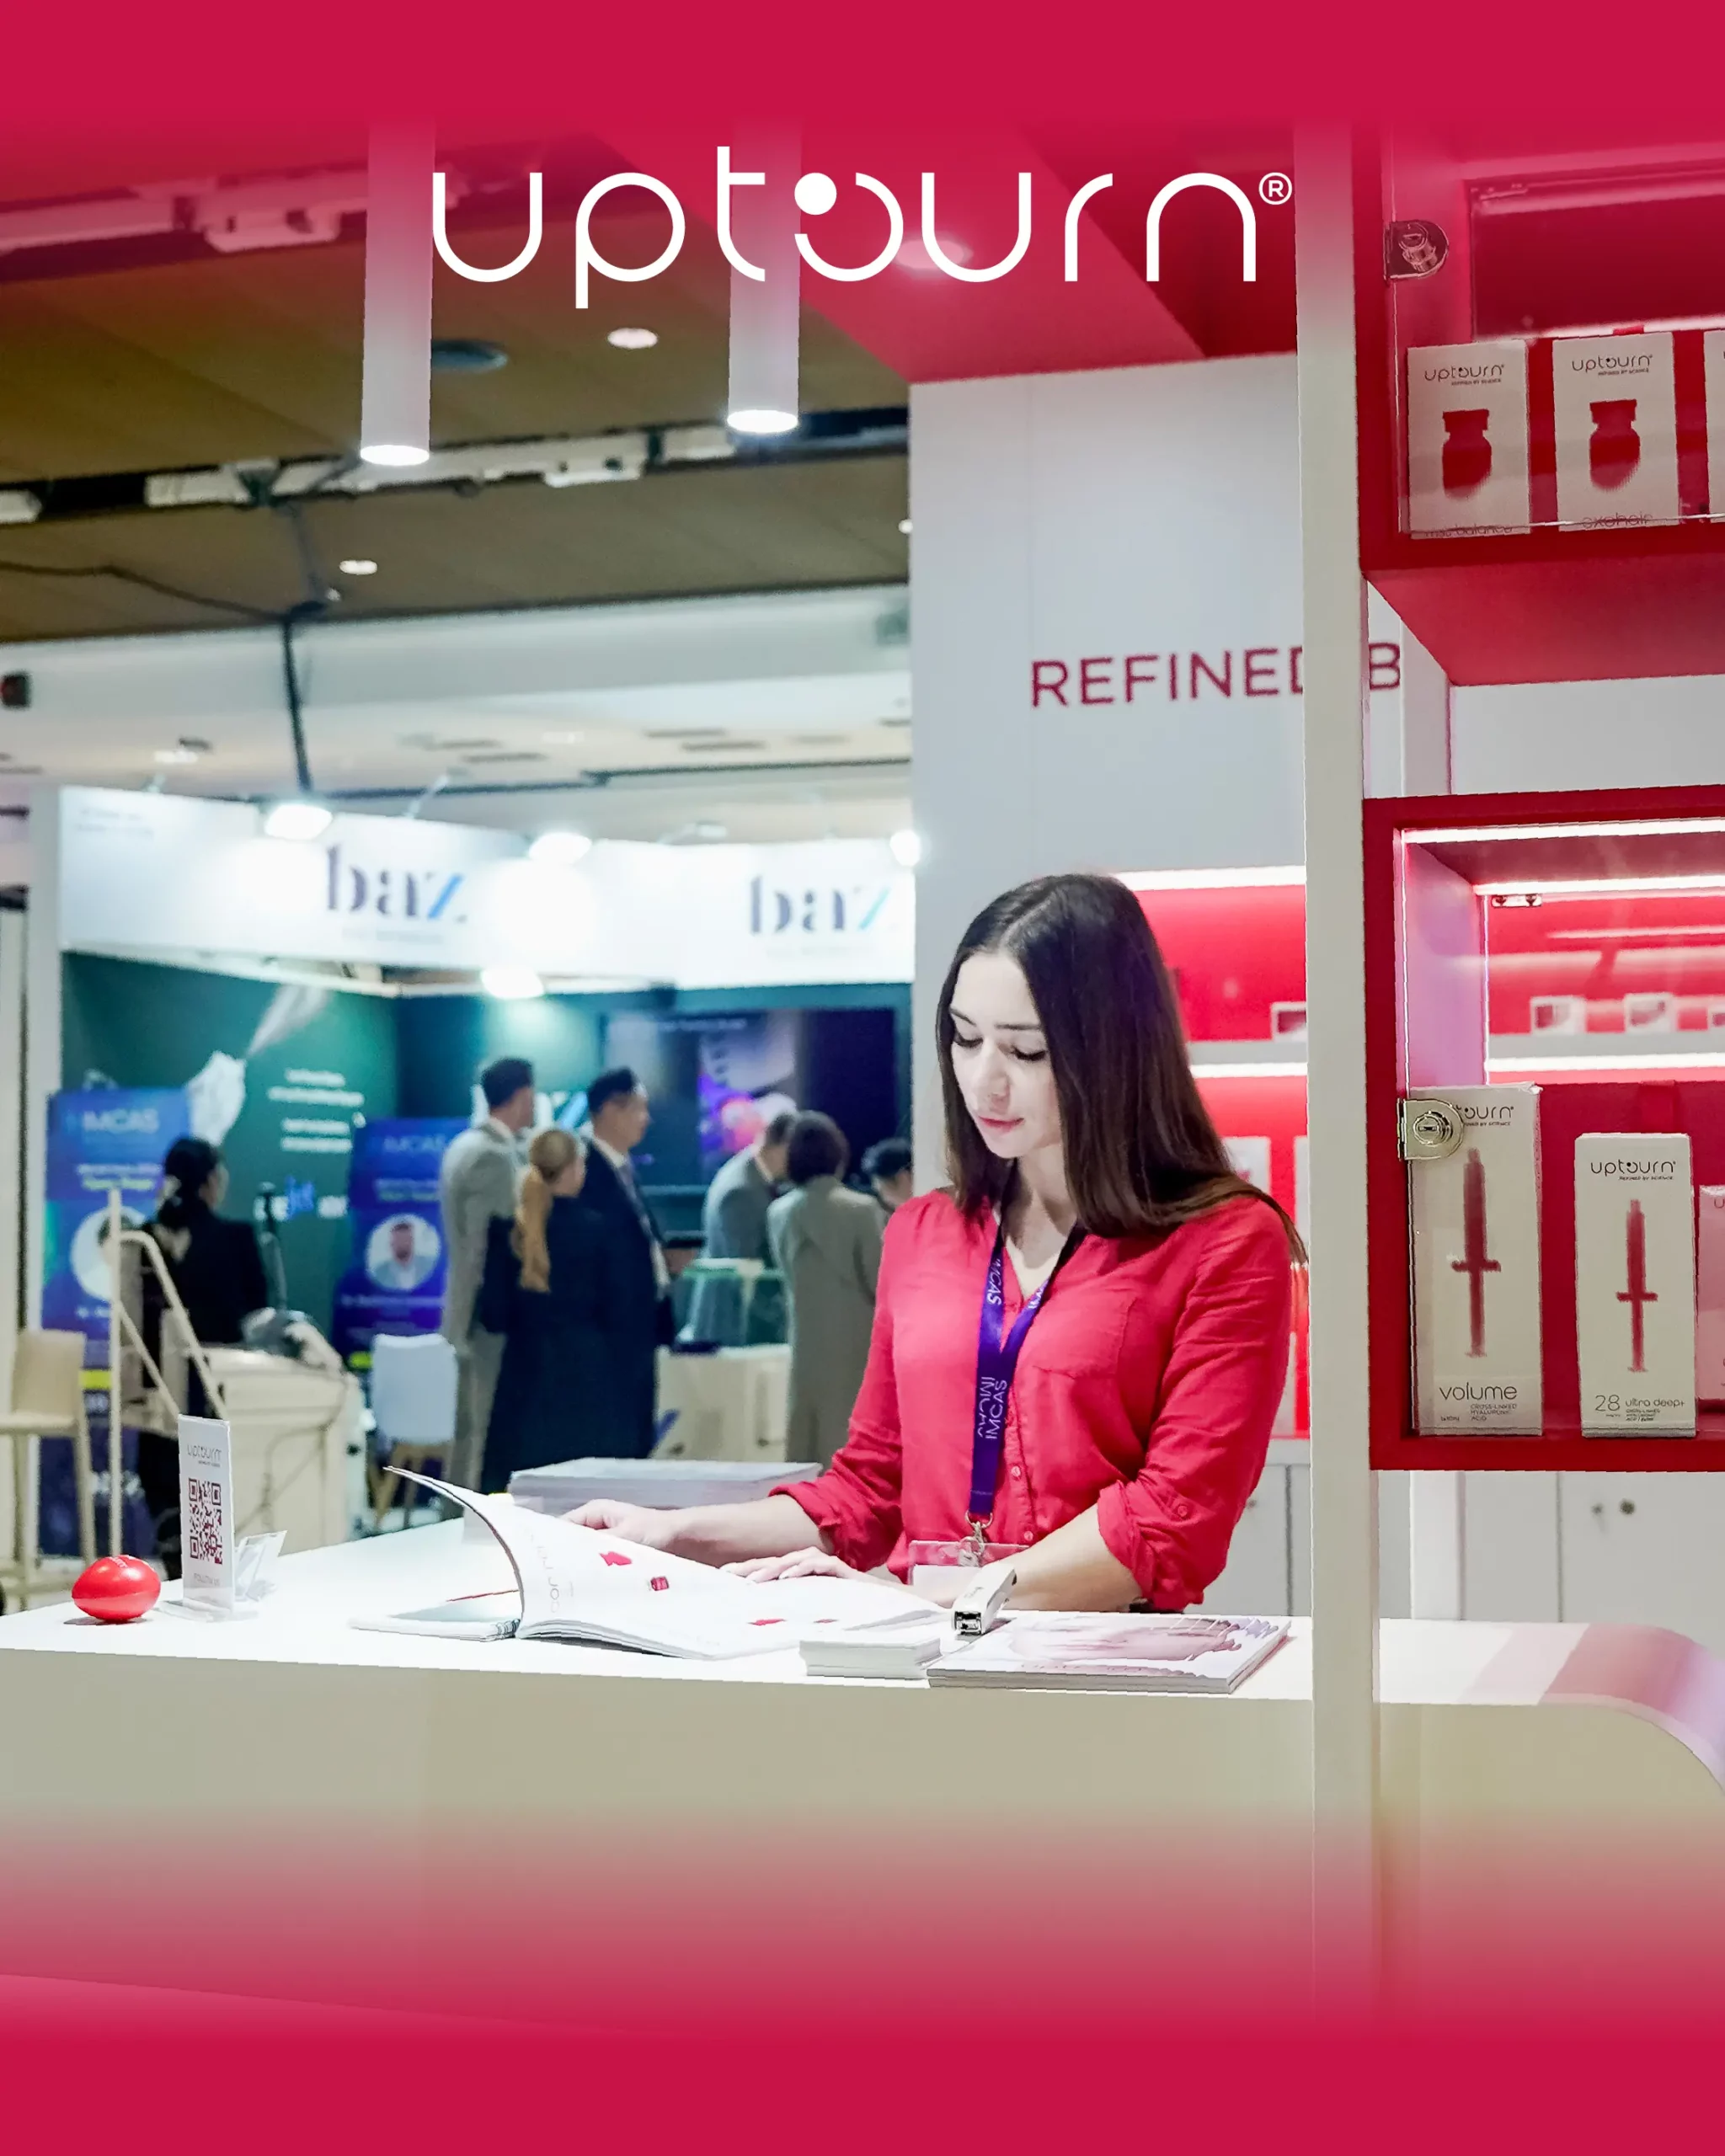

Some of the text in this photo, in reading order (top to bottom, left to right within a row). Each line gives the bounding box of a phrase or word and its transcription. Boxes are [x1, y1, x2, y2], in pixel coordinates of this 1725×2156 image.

[1030, 645, 1303, 708] REFINE
[985, 1380, 1007, 1439] IMCAS
[1439, 1381, 1518, 1401] volume
[1594, 1394, 1621, 1412] 28
